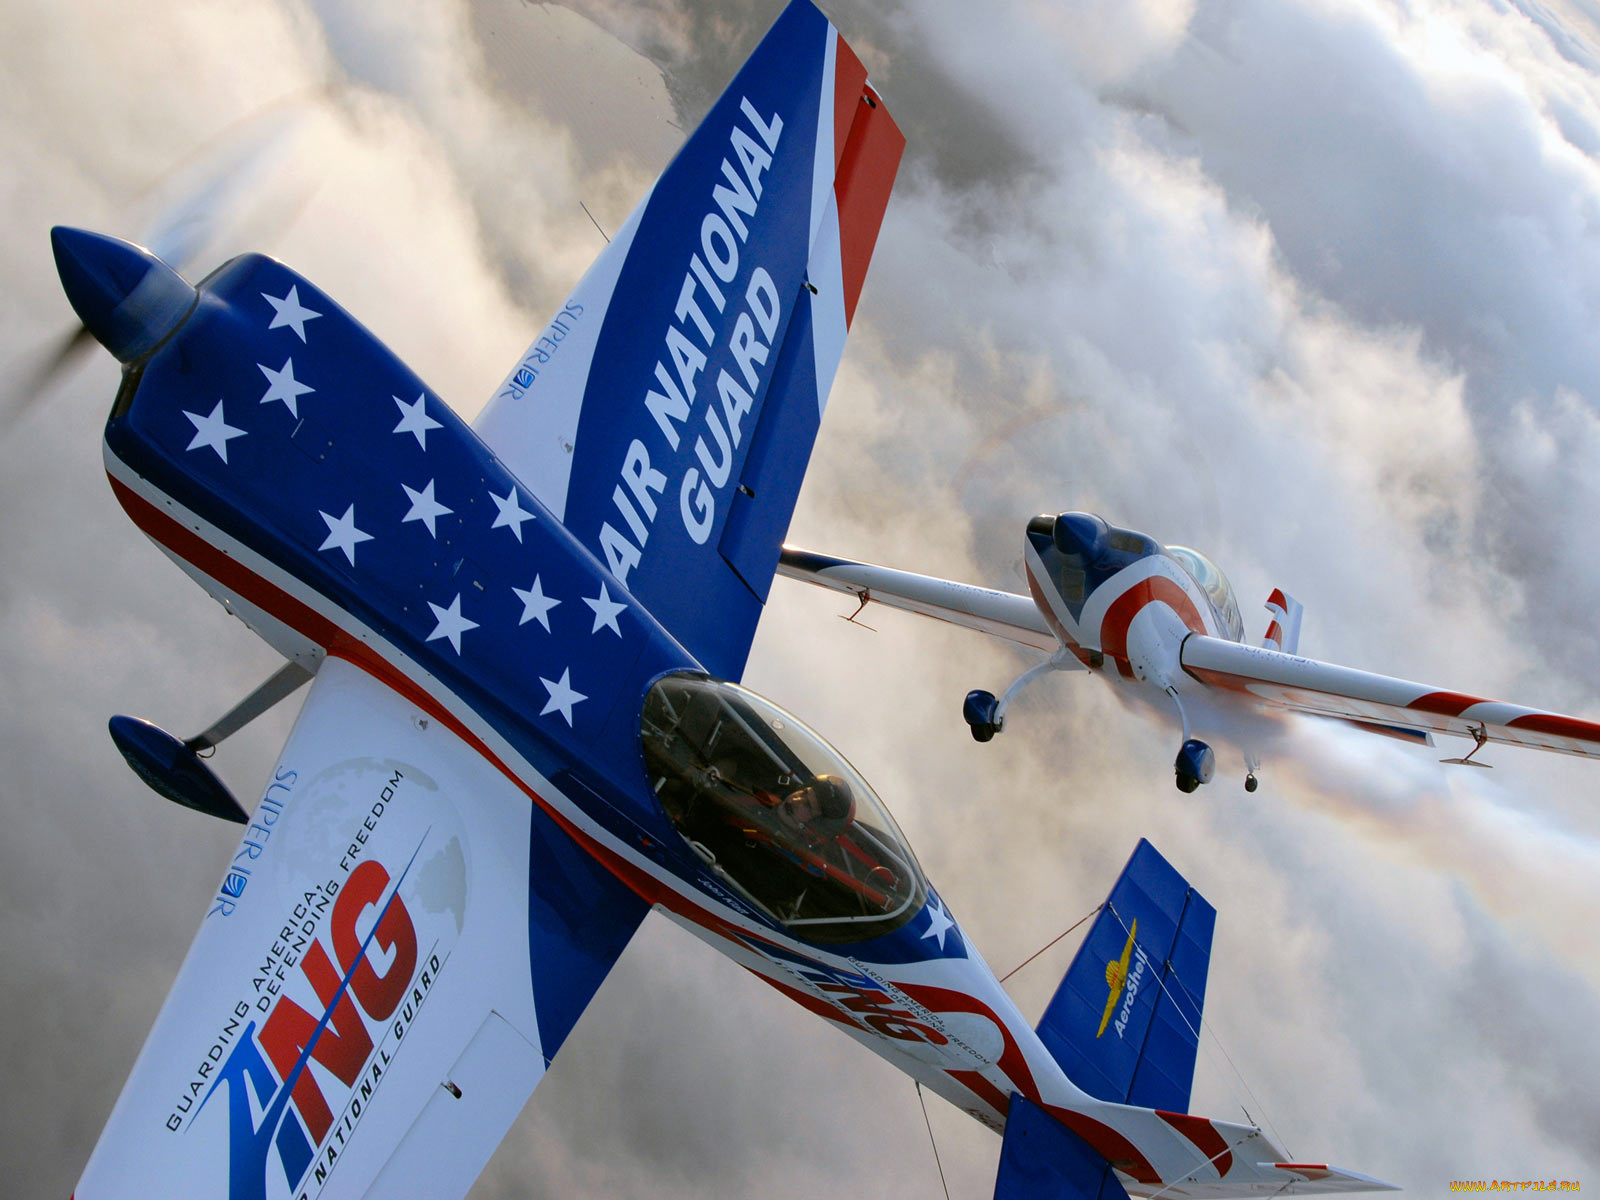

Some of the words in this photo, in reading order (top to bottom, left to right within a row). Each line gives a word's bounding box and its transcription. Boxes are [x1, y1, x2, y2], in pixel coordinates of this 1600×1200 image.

[599, 438, 668, 592] AIR
[643, 95, 784, 452] NATIONAL
[680, 266, 781, 545] GUARD
[166, 1000, 250, 1132] GUARDING
[252, 884, 326, 993] AMERICA,
[256, 878, 340, 1014] DEFENDING
[339, 769, 404, 872] FREEDOM
[848, 956, 900, 994] GUARDING
[1114, 946, 1148, 1039] AeroShell
[184, 859, 418, 1200] ANG
[314, 1051, 391, 1186] NATIONAL
[394, 954, 441, 1041] GUARD
[890, 994, 947, 1033] DEFENDING
[947, 1034, 991, 1065] FREEDOM
